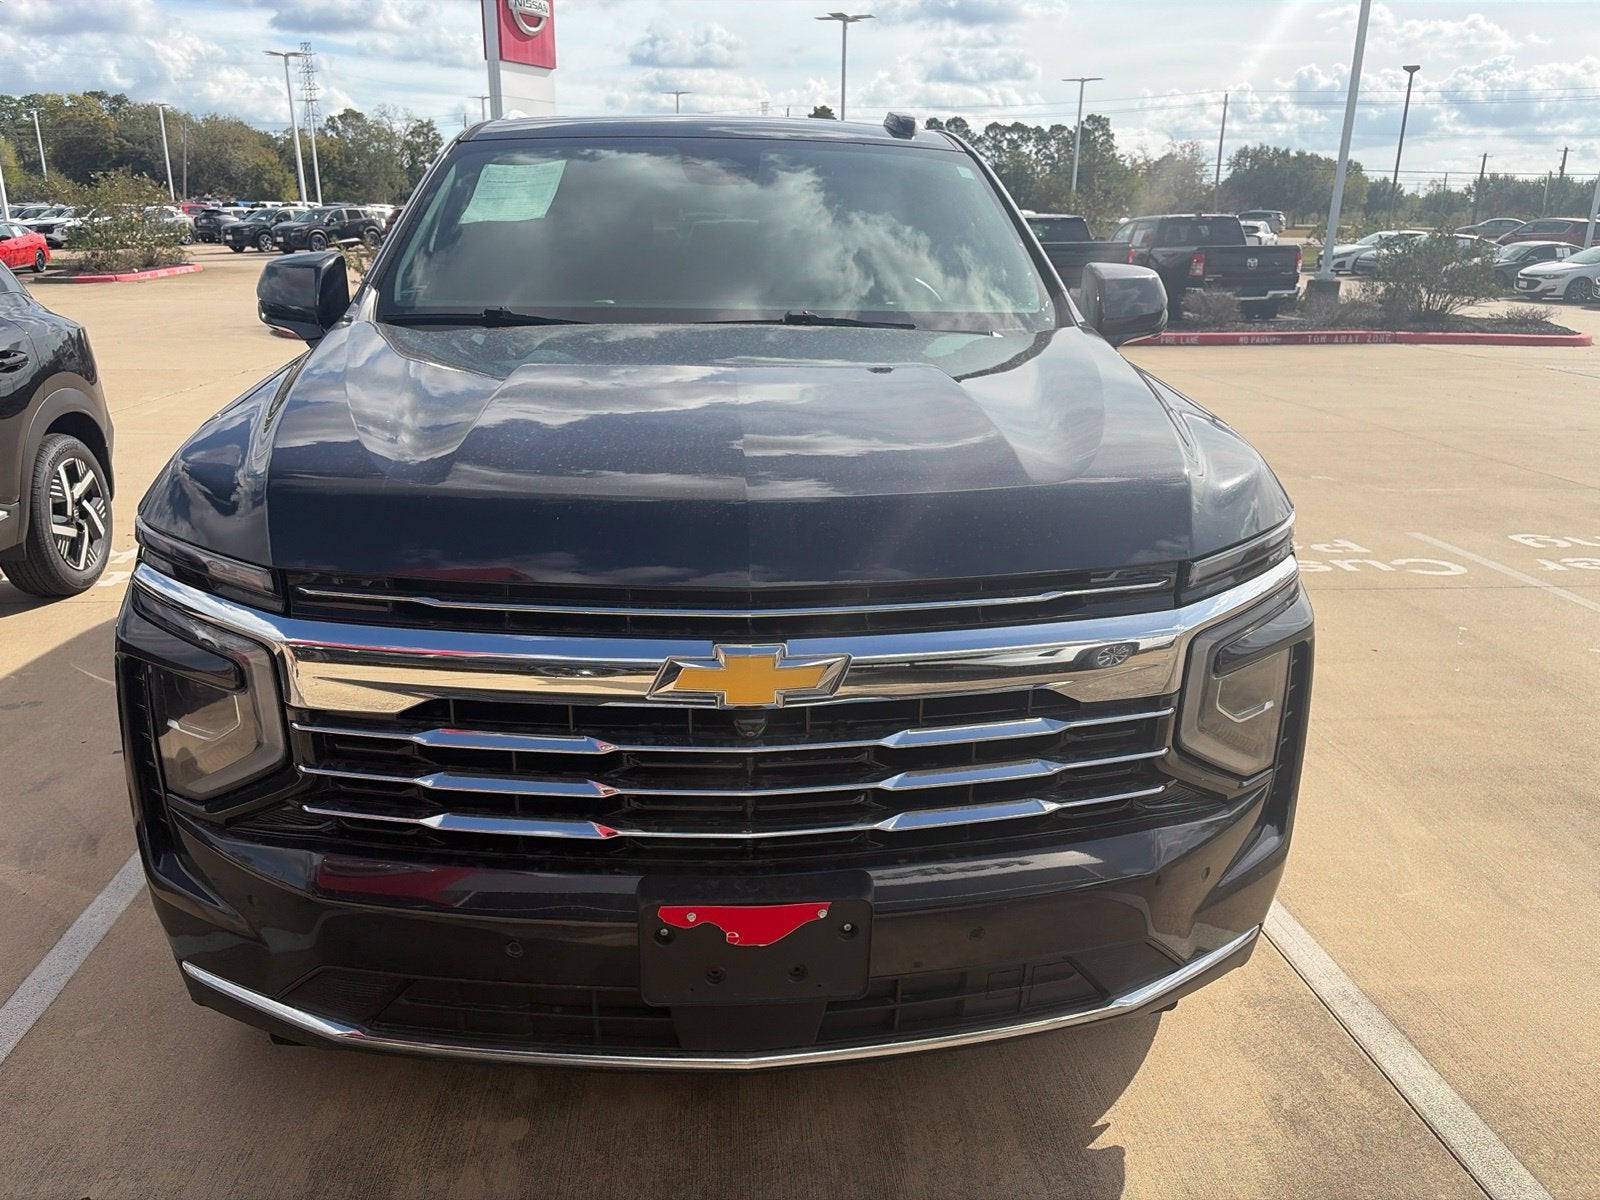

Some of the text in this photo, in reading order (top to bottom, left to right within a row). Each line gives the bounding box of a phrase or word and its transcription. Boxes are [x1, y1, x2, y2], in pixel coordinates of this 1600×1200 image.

[514, 0, 548, 13] NISSAN
[1160, 336, 1199, 344] FIRE LANE
[1239, 336, 1249, 345] NO
[1307, 334, 1391, 344] TOW AWAY ZONE
